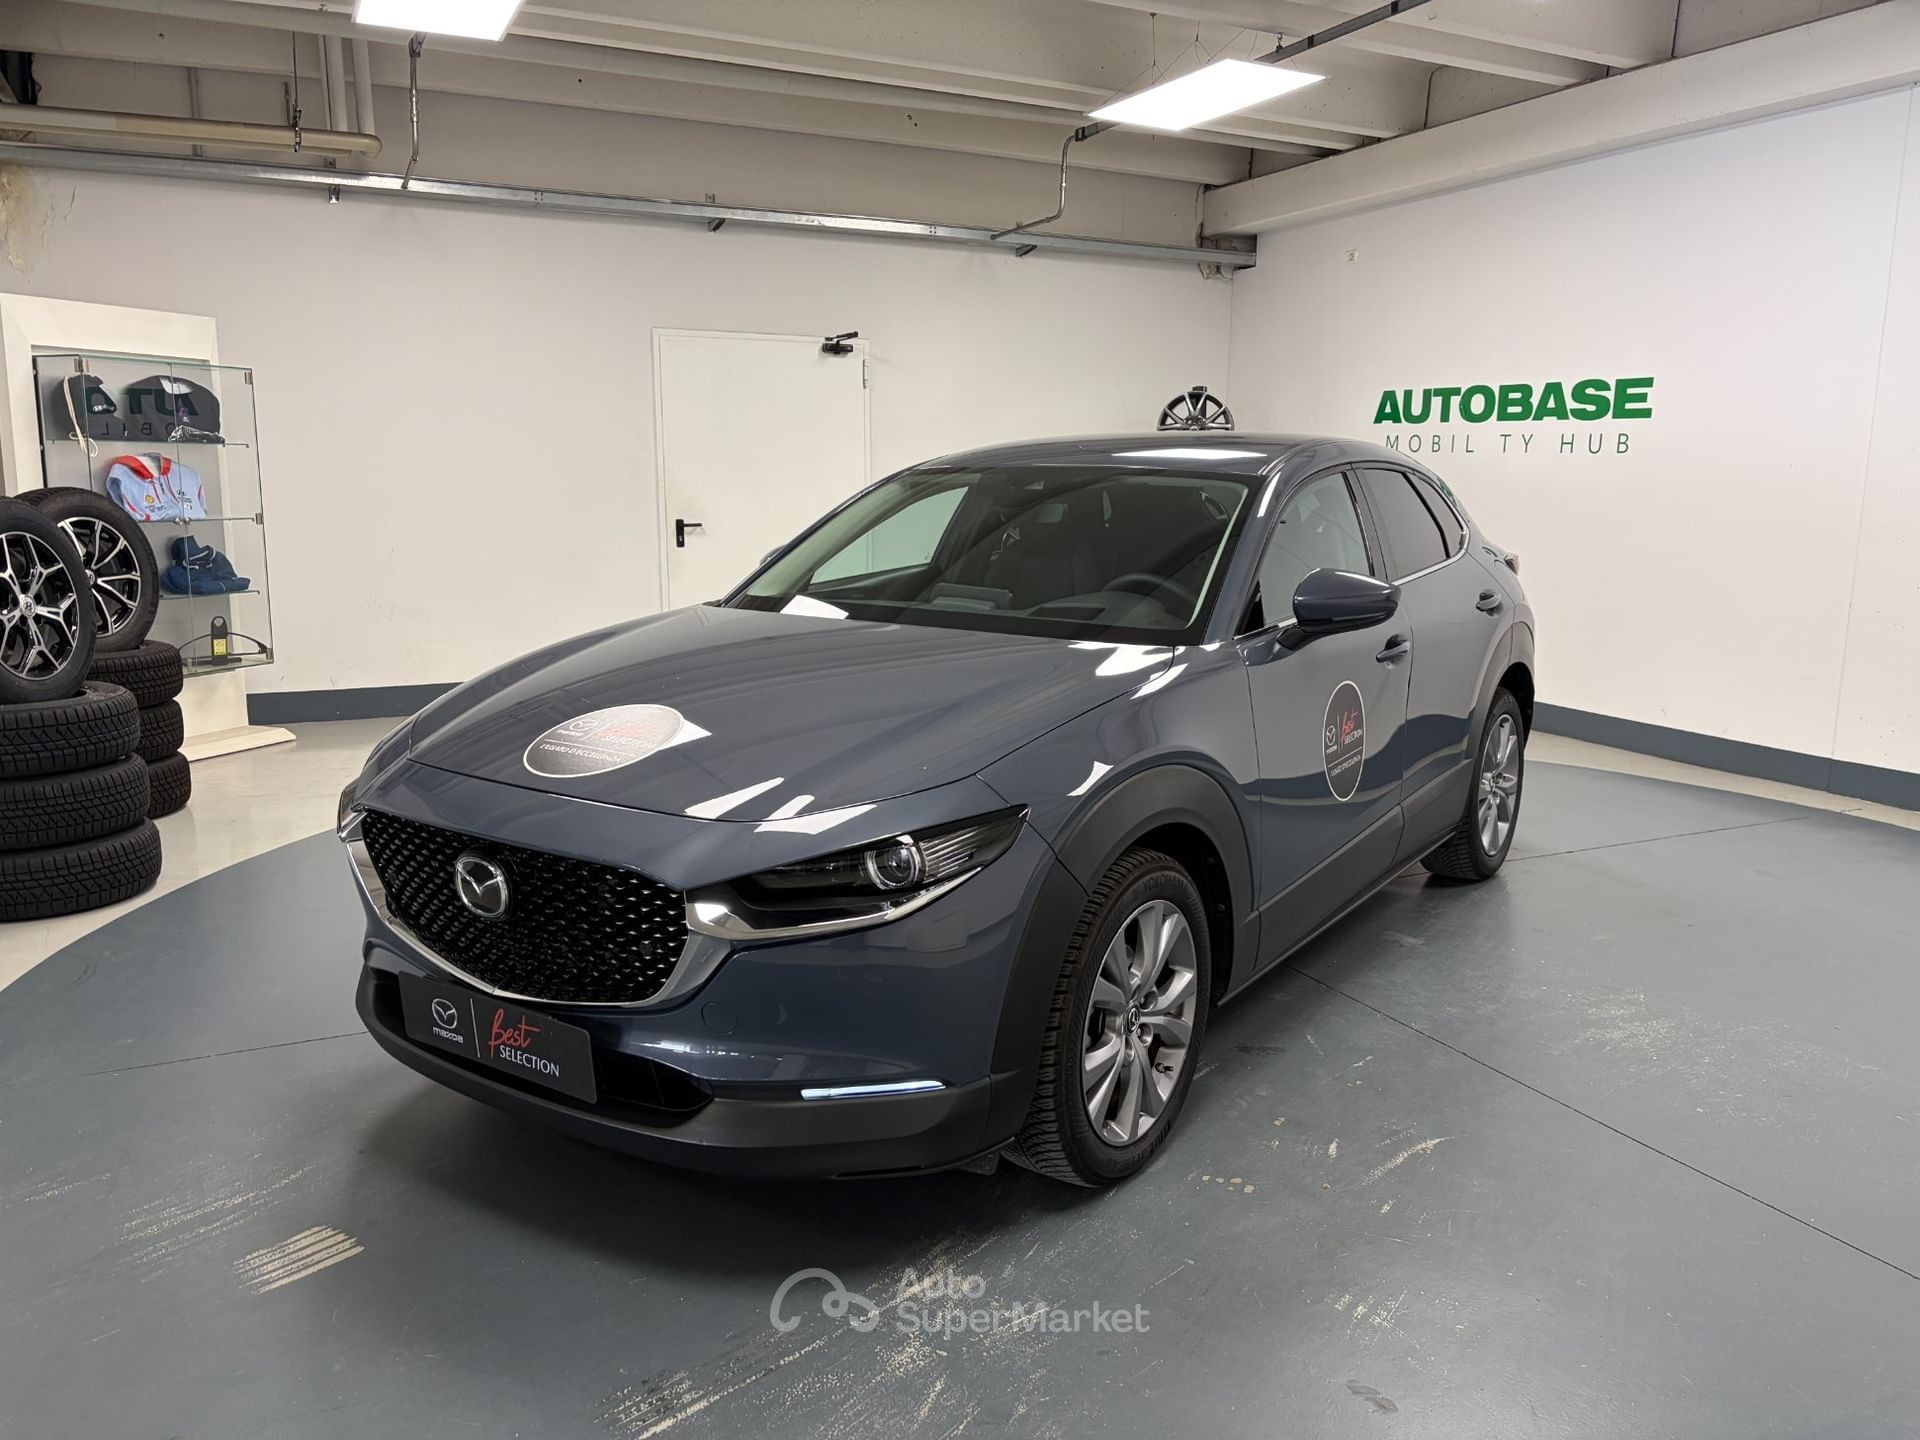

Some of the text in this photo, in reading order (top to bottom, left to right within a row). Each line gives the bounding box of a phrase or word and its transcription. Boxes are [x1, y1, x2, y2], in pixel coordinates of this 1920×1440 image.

[1373, 377, 1654, 424] AUTOBASE
[1559, 432, 1630, 455] HUB
[432, 1026, 464, 1044] mazda
[499, 1044, 560, 1078] SELECTION
